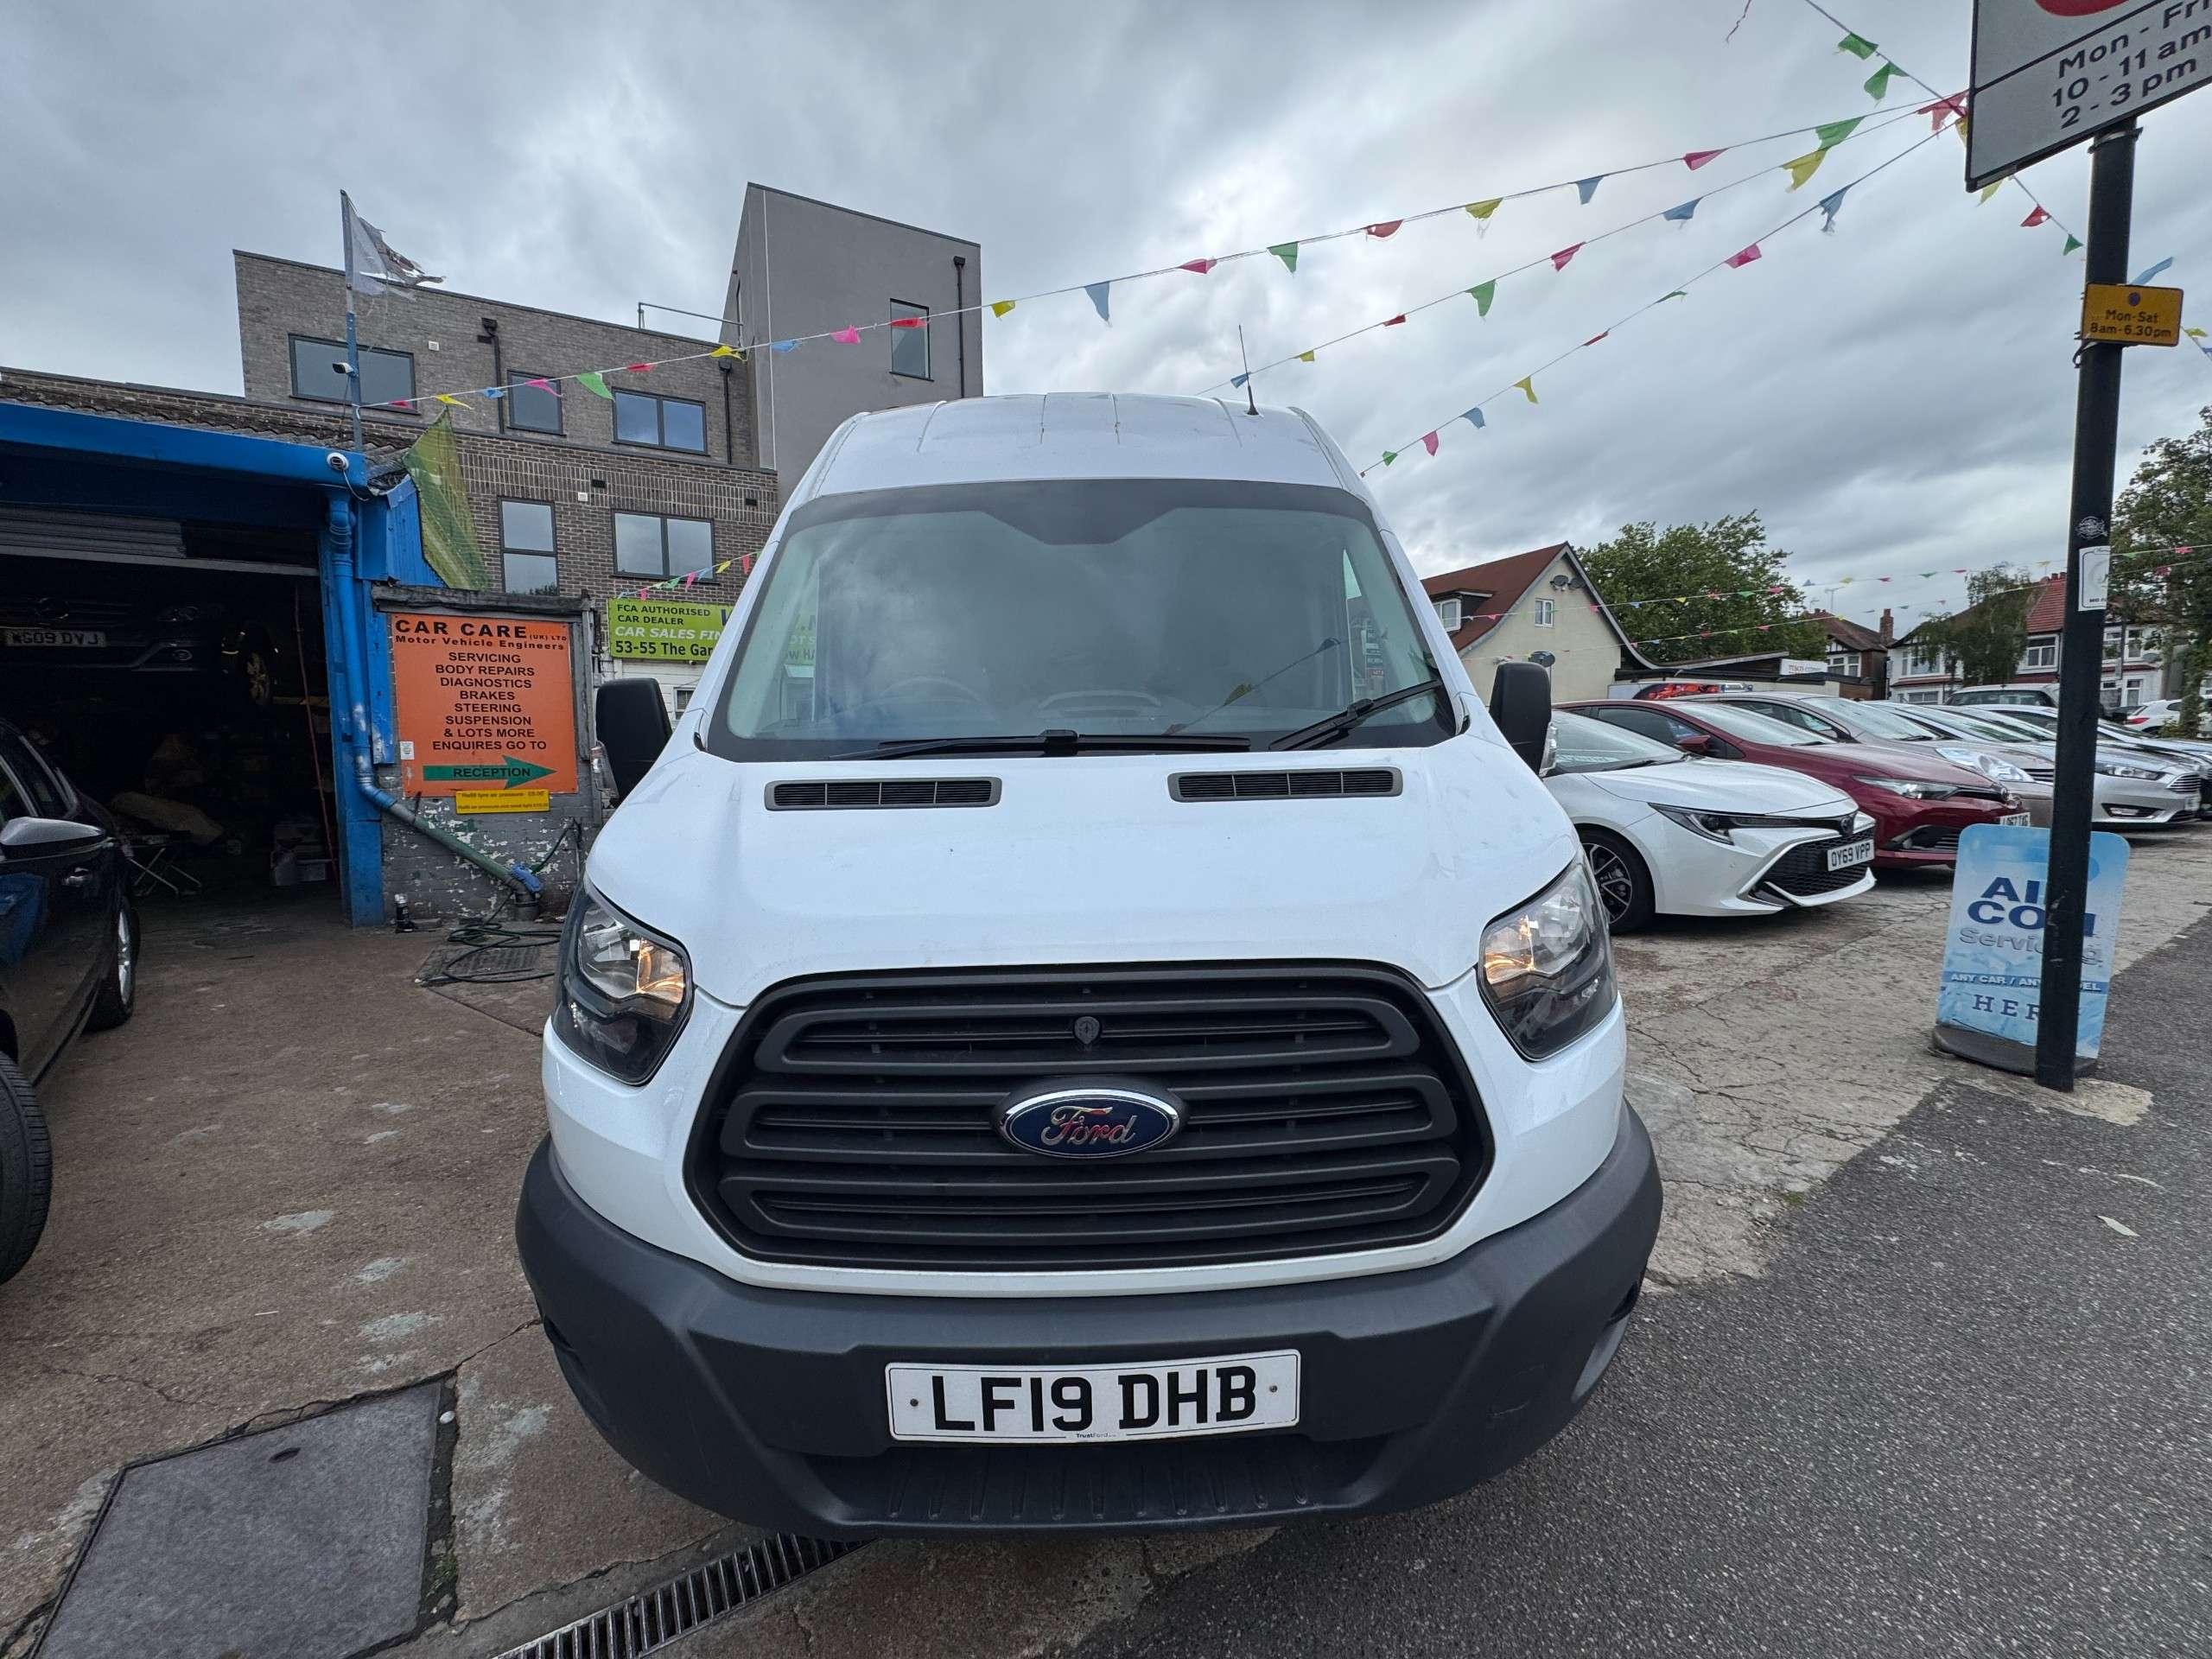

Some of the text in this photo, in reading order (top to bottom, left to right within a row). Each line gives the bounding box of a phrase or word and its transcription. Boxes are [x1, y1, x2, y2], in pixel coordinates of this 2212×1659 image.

[2059, 35, 2128, 79] Mon
[2163, 0, 2210, 29] Fri
[2052, 77, 2088, 107] 10
[2119, 48, 2147, 77] 11
[2157, 24, 2211, 60] am
[2061, 105, 2081, 130] 2
[2110, 82, 2132, 106] 3
[2141, 58, 2197, 98] pm
[641, 606, 710, 616] AUTHORISED
[618, 614, 683, 625] CAR DEALER
[395, 620, 448, 635] CAR
[461, 623, 527, 639] CARE
[615, 626, 645, 637] CAR
[650, 627, 696, 639] SALES
[395, 635, 564, 651] Motor Vehicle Engineers
[615, 640, 657, 654] 53-55
[661, 642, 686, 656] The
[448, 652, 521, 664] SERVICING
[435, 664, 535, 677] BODY REPAIRS
[440, 677, 532, 689] DIAGNOSTICS
[460, 690, 515, 701] BRAKES
[454, 702, 522, 713] STEERING
[445, 715, 531, 726] SUSPENSION
[443, 728, 535, 738] & LOTS MORE
[433, 741, 547, 750] ENQUIRES GO TO
[453, 767, 531, 778] RECEPTION
[1855, 842, 1871, 860] VPP
[1980, 877, 2040, 904] AI
[1951, 973, 1975, 983] ANY
[1979, 975, 2005, 984] CAR
[1972, 994, 2040, 1020] HER
[1040, 1105, 1138, 1146] Ford
[931, 1365, 1257, 1432] LF19 DHB
